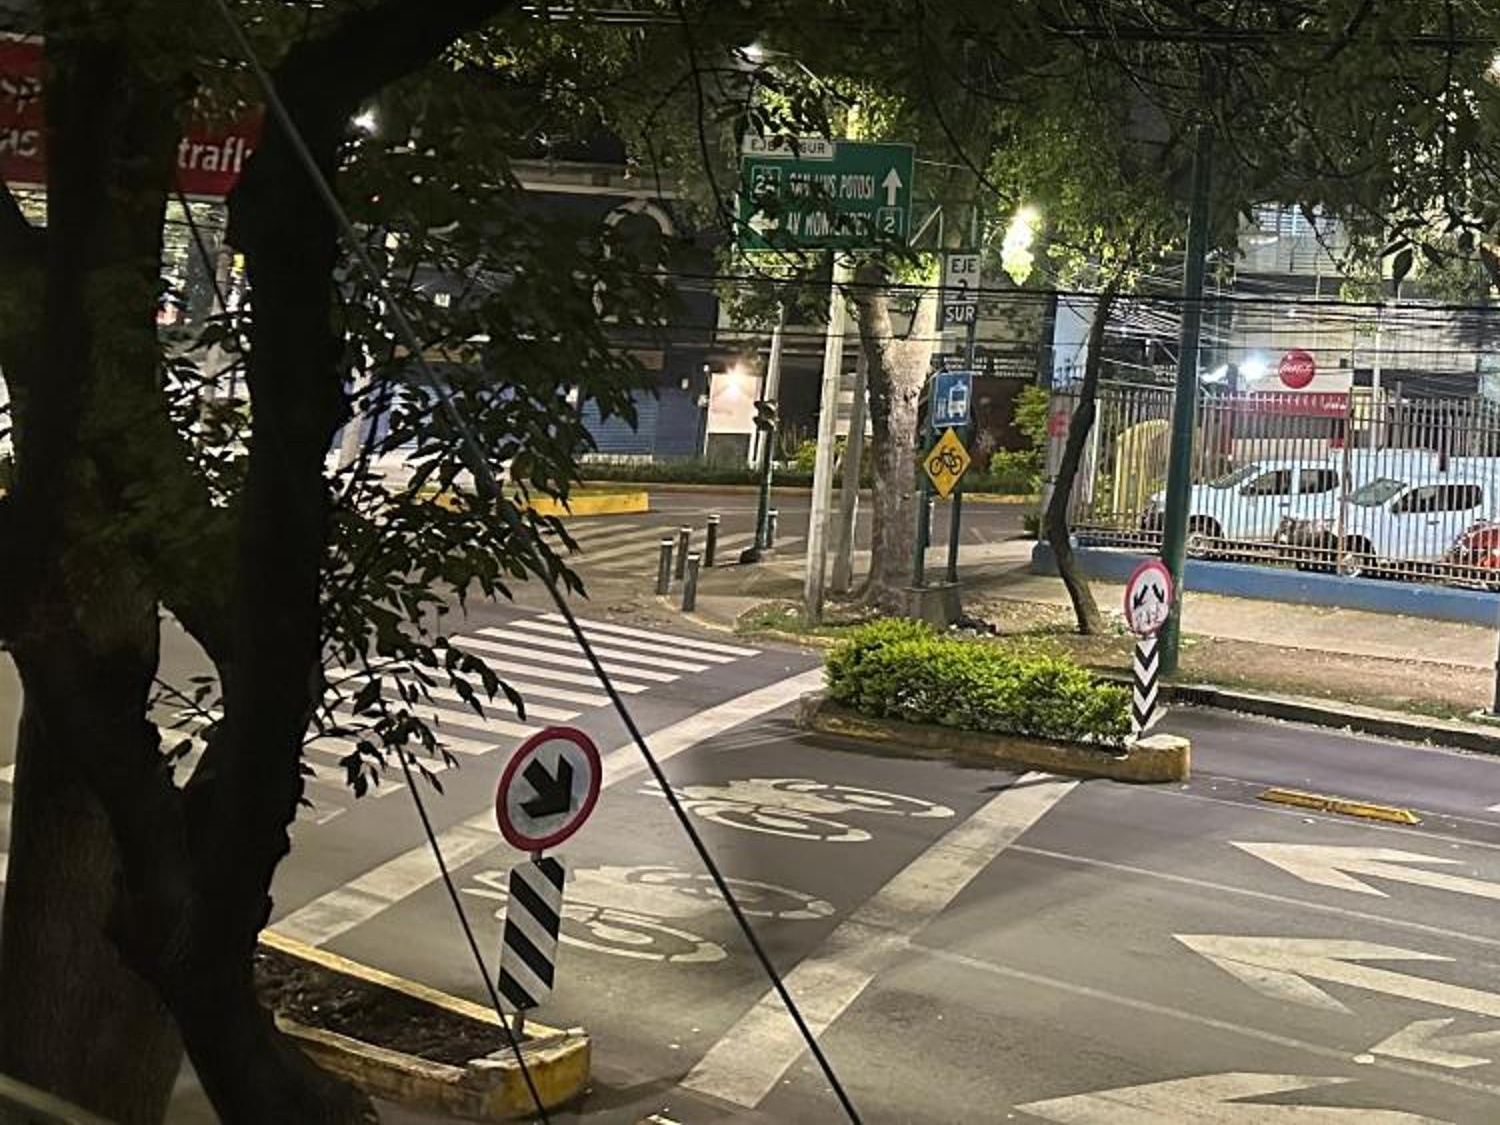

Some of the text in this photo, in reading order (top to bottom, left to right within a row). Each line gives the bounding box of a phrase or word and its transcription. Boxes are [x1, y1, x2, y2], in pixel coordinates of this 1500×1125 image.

[178, 136, 252, 173] trafl
[839, 174, 875, 200] POTOSI
[883, 216, 895, 234] 2
[951, 258, 977, 274] EJE
[957, 279, 968, 301] 2
[945, 305, 975, 323] SUR
